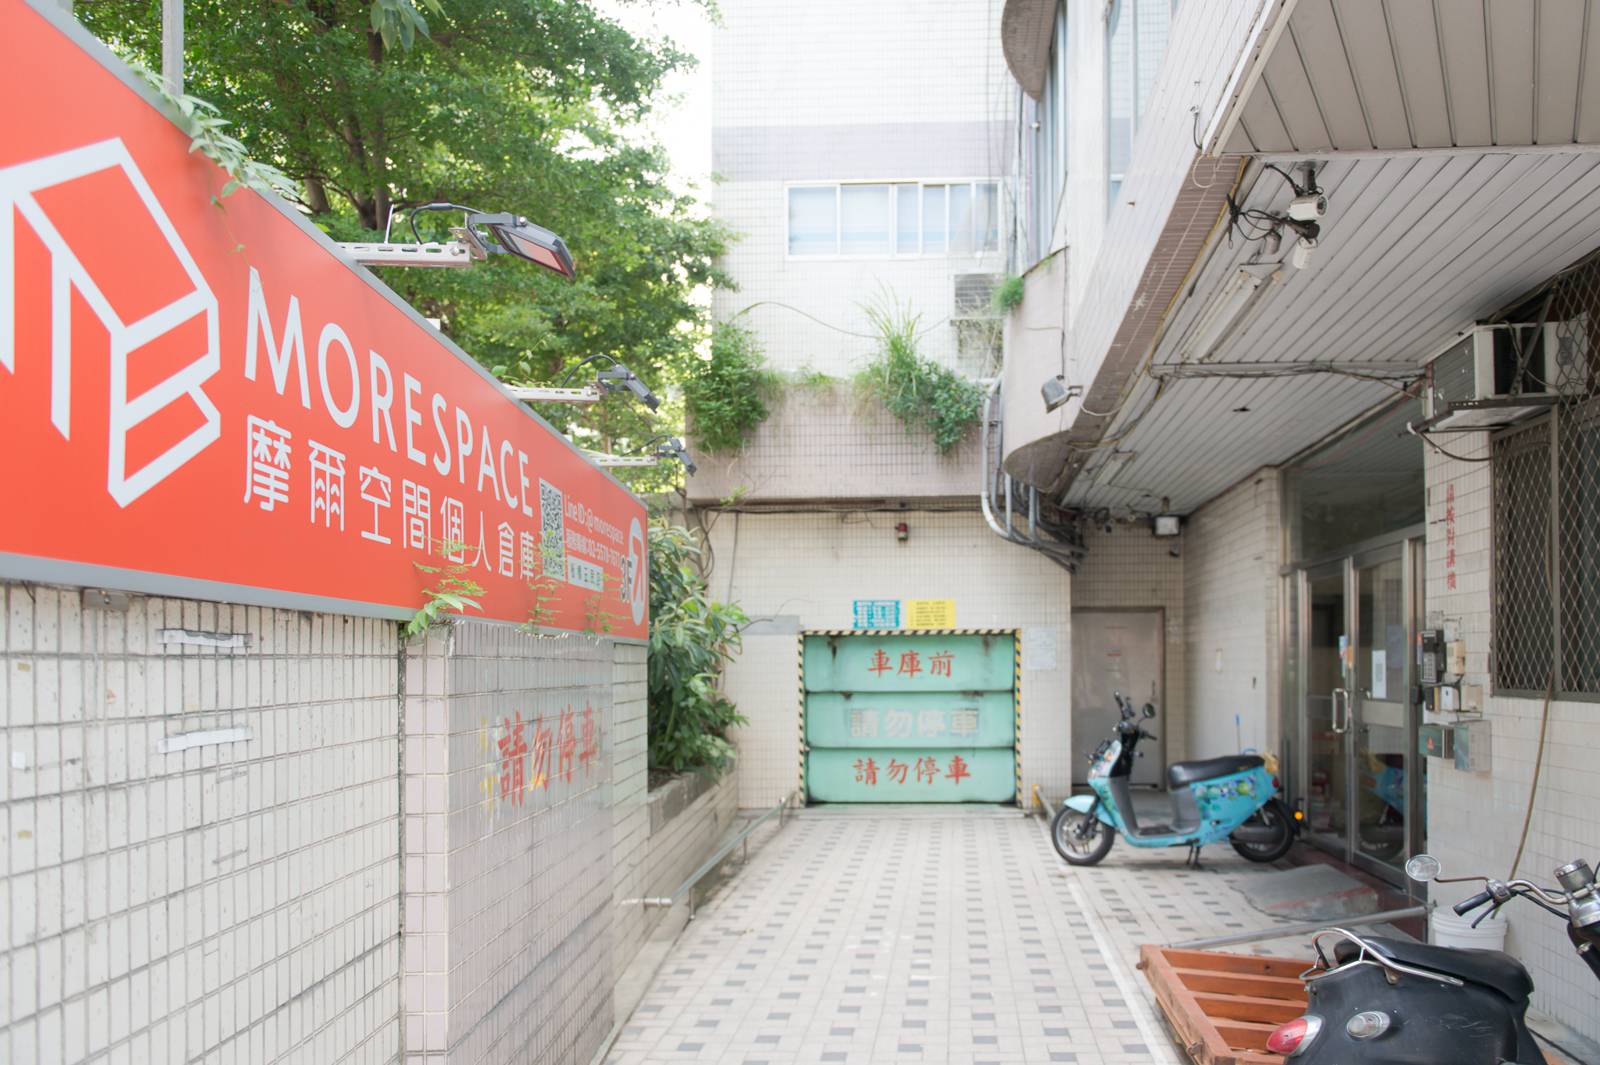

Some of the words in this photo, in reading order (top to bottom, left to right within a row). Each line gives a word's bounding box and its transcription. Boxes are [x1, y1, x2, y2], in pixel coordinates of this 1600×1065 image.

[244, 265, 533, 517] MORESPACE
[244, 414, 535, 581] 摩爾空間個人倉庫
[867, 648, 956, 678] 車庫前
[498, 700, 598, 809] 請勿停車
[850, 707, 980, 738] 請勿停車
[853, 755, 973, 787] 請勿停車
